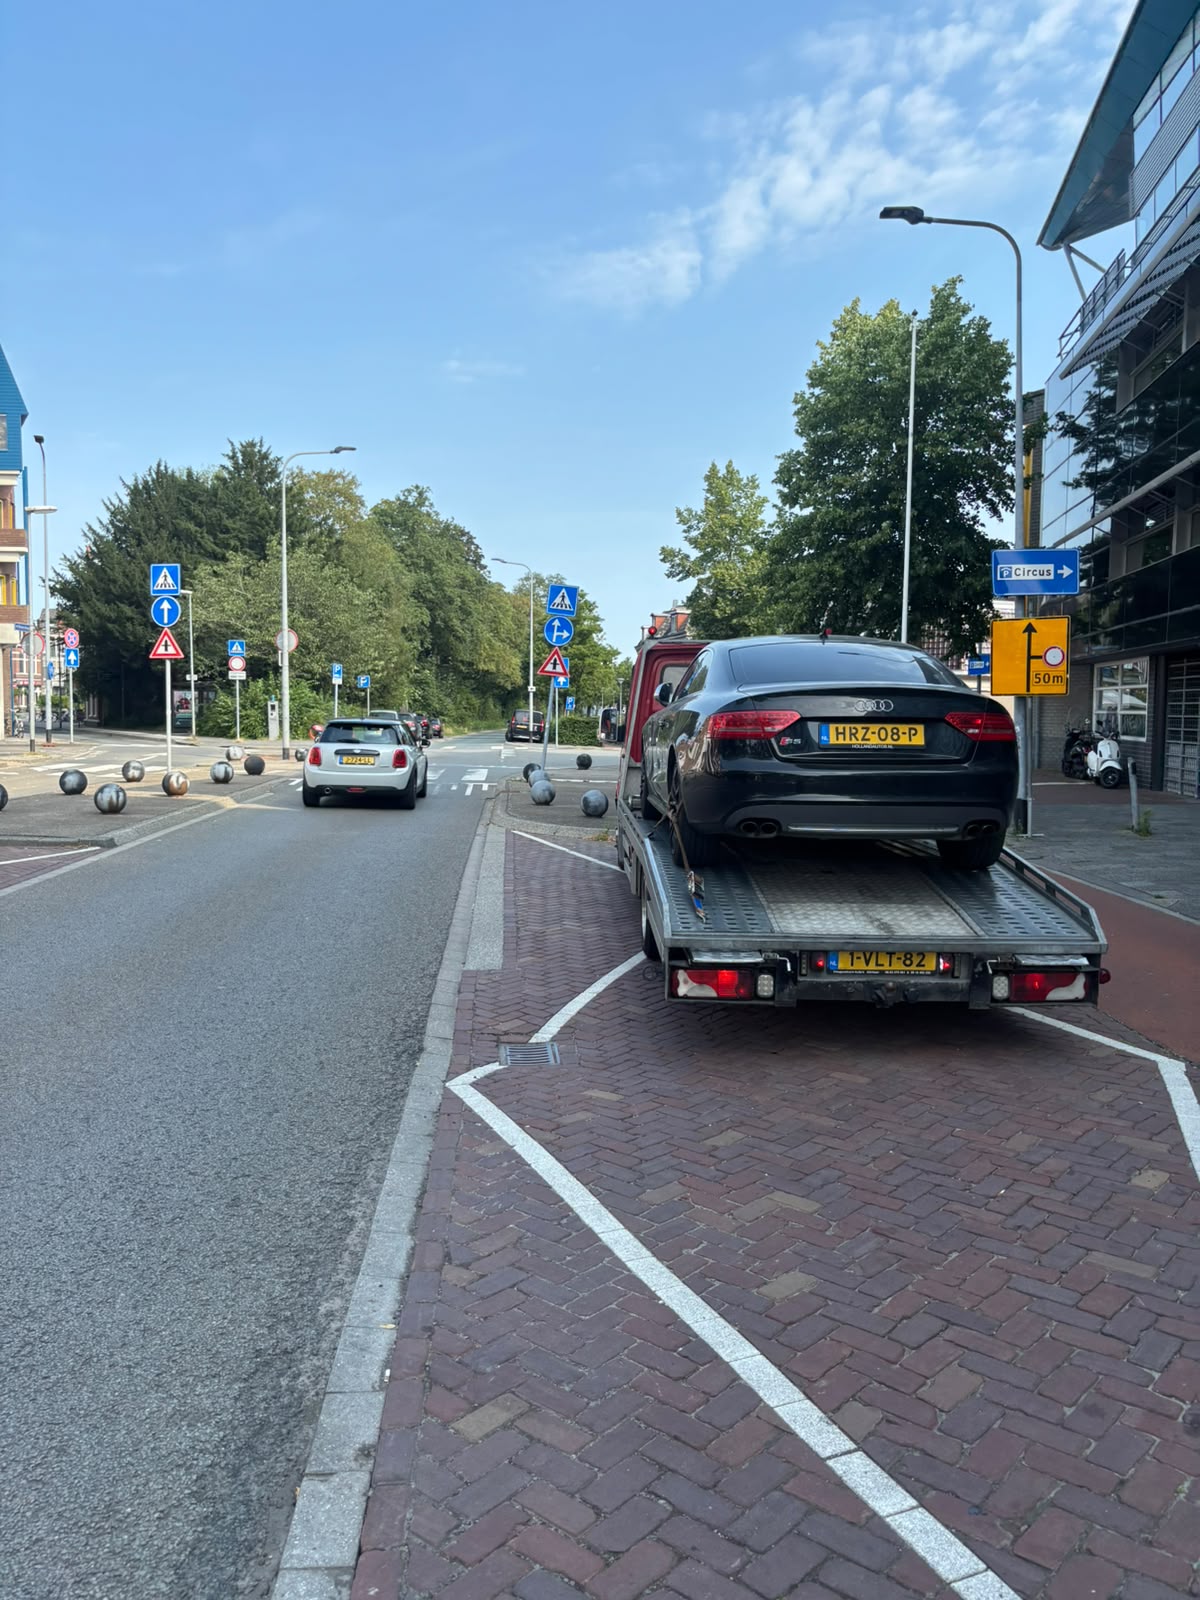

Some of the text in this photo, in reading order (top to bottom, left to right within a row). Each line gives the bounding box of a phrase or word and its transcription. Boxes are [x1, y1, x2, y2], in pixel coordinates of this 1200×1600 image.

[1014, 567, 1052, 577] Circus
[835, 726, 918, 742] HRZ-08-P
[849, 952, 926, 967] 1-VLT-82
